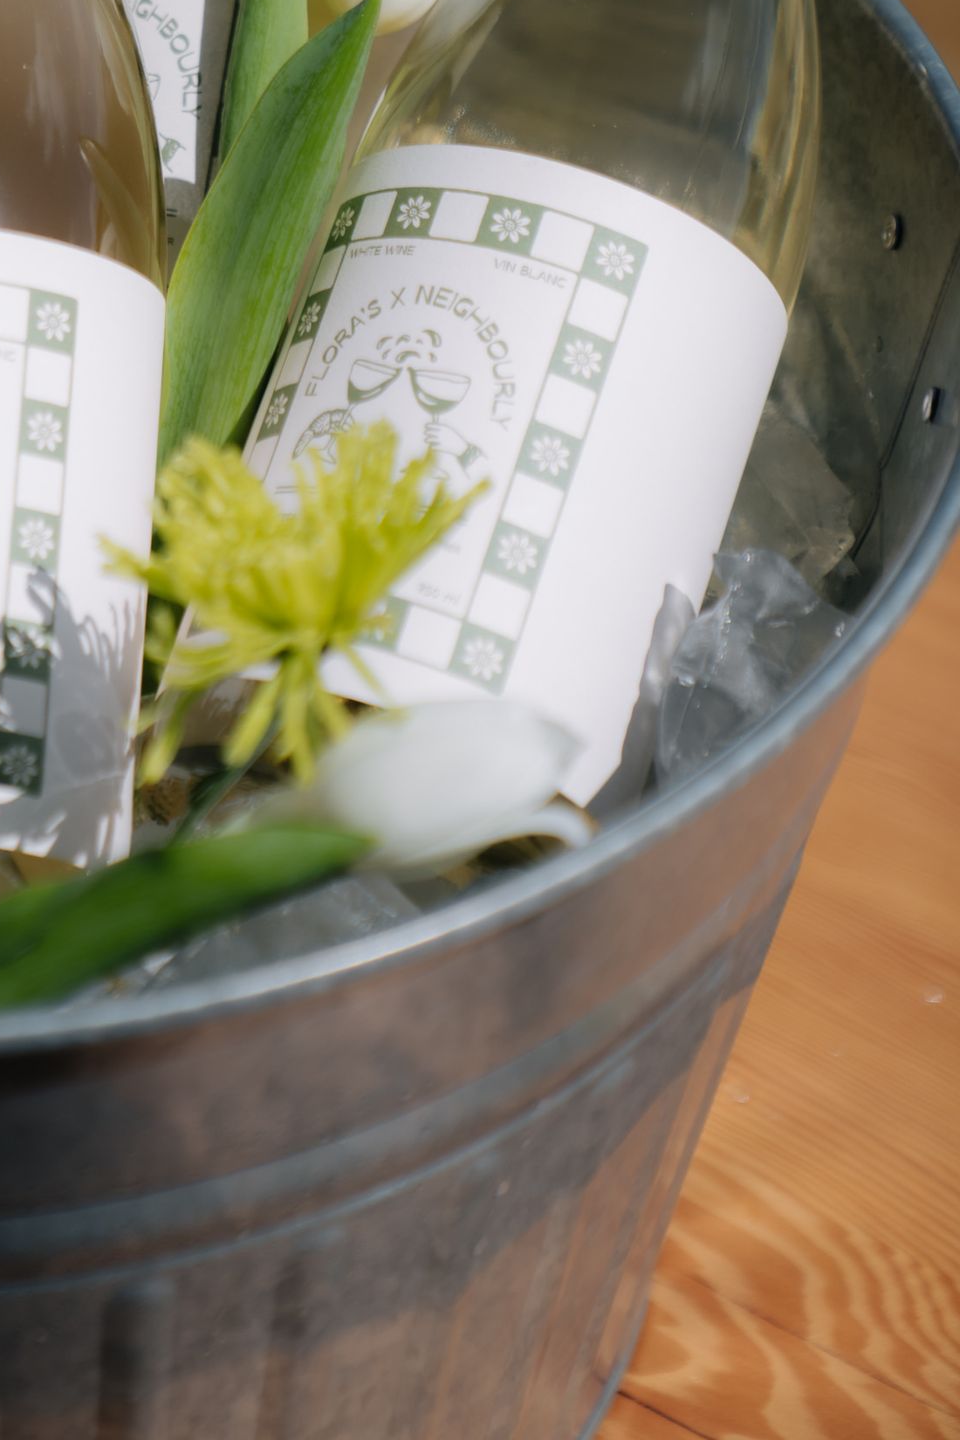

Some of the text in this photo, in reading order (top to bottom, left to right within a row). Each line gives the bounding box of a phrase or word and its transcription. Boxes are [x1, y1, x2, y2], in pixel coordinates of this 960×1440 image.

[350, 245, 416, 259] WHITE WINE
[493, 258, 569, 289] VIN BLANC
[304, 284, 517, 432] FLORA'S X NEIGHBOURLY
